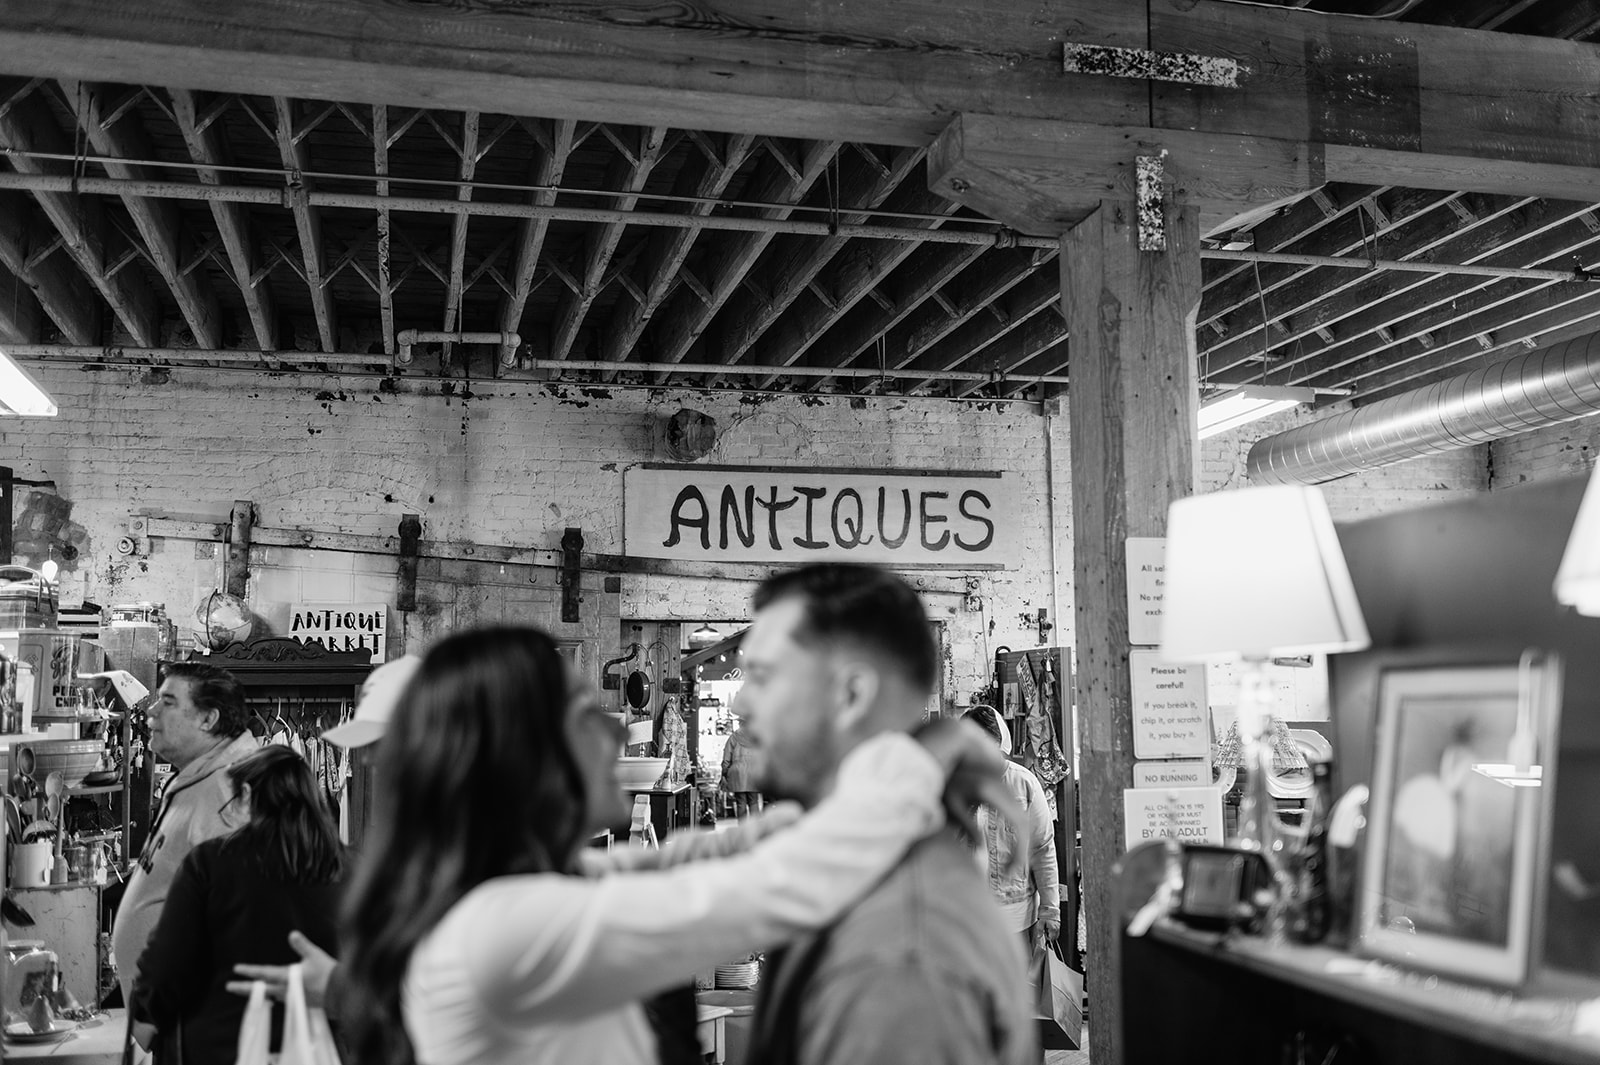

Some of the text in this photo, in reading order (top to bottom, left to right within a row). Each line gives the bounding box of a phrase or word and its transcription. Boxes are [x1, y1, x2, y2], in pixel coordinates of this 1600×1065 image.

[662, 484, 995, 552] ANTIQUES
[1141, 564, 1166, 572] All sal
[1155, 578, 1166, 587] fin
[1153, 593, 1165, 601] ref
[1145, 608, 1164, 616] exch
[291, 609, 385, 632] ANTIQUE
[1167, 701, 1188, 709] break
[1141, 716, 1156, 725] chip
[1177, 715, 1202, 724] scratch
[1158, 732, 1171, 740] you
[1173, 731, 1186, 740] buy
[1145, 774, 1198, 783] NO RUNNING
[1142, 828, 1155, 838] BY
[1177, 826, 1208, 837] ADULT
